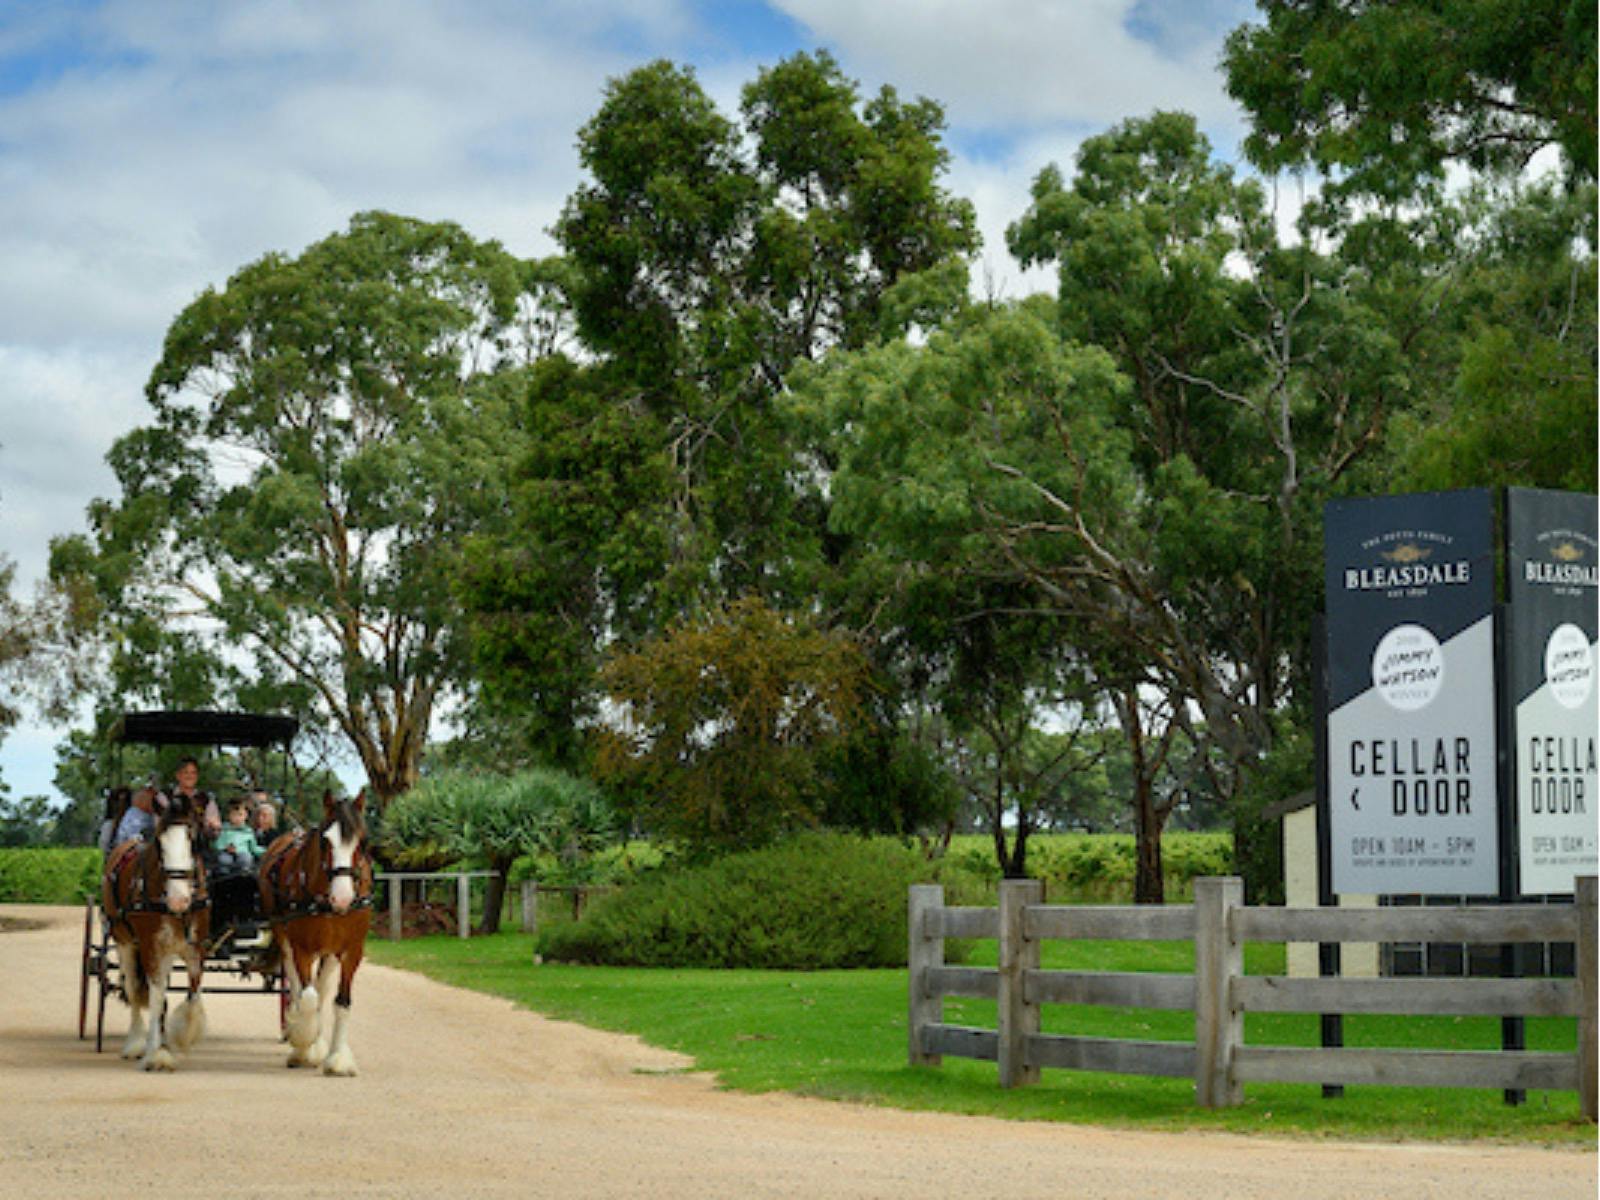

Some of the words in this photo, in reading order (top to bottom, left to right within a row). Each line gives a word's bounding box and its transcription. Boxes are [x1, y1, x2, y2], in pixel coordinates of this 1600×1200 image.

[1345, 560, 1471, 590] BLEASDALE
[1379, 664, 1441, 687] WATSON
[1381, 646, 1434, 672] JIMMY
[1350, 736, 1472, 777] CELLAR
[1530, 736, 1598, 773] CELLA
[1392, 778, 1472, 817] DOOR
[1531, 777, 1586, 814] DOOR
[1351, 836, 1386, 856] OPEN
[1391, 836, 1426, 855] 10AM
[1446, 836, 1476, 854] 5PM
